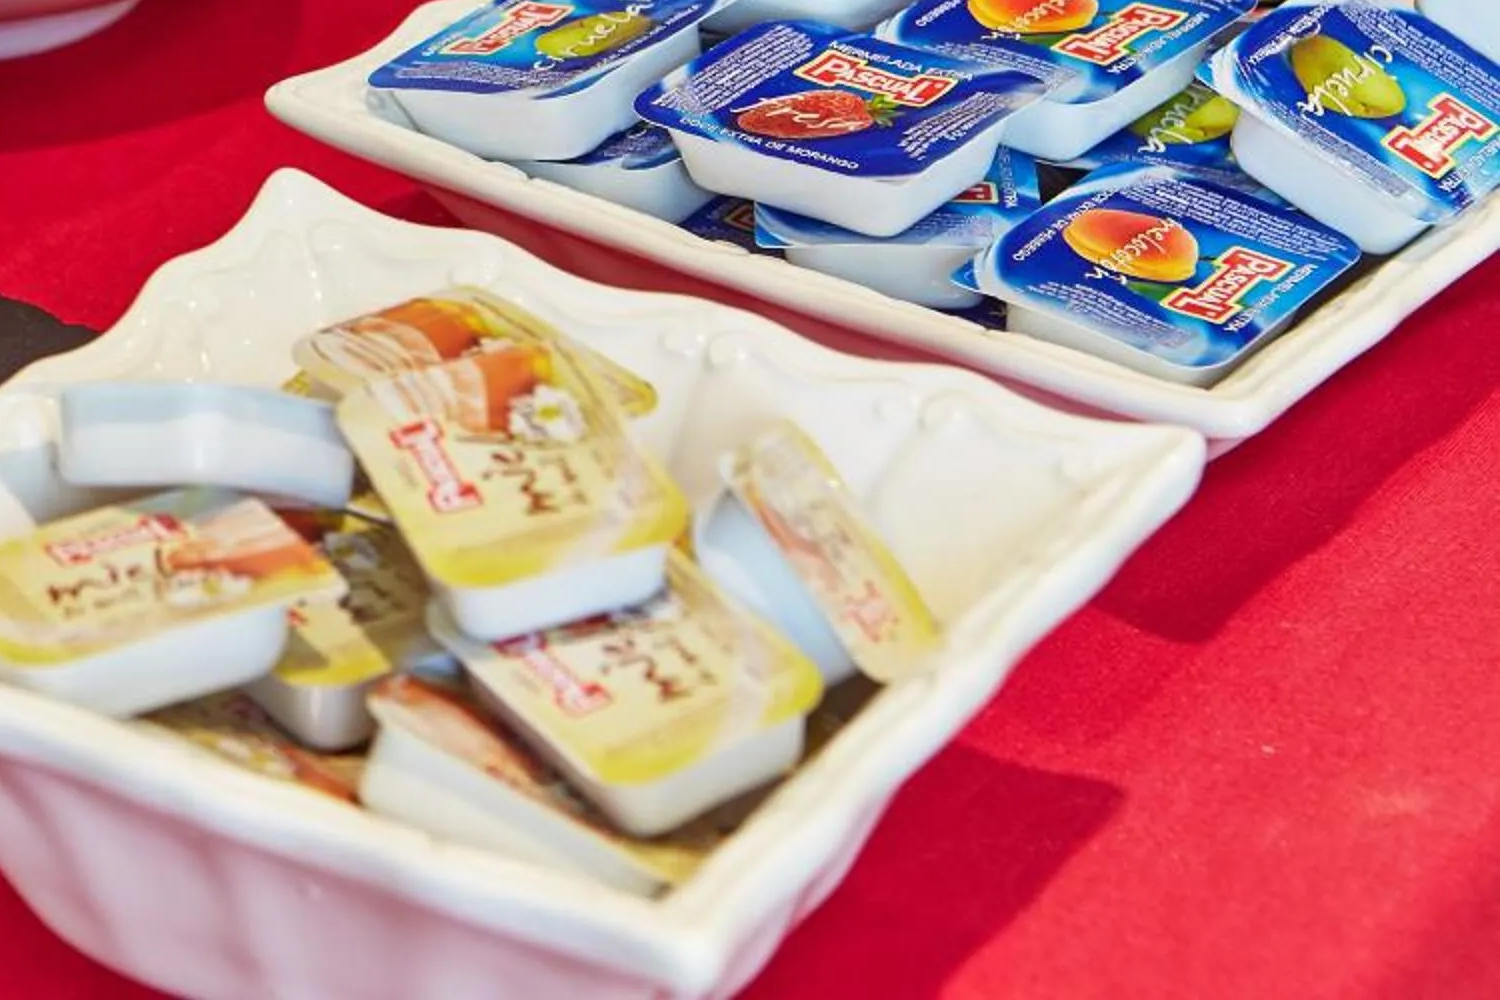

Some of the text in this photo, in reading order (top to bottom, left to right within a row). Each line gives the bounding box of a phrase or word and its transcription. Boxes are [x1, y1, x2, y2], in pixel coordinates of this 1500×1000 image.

[812, 56, 940, 104] PASCUAL
[788, 144, 860, 171] MORANGO
[1174, 251, 1282, 320] PASCUAL
